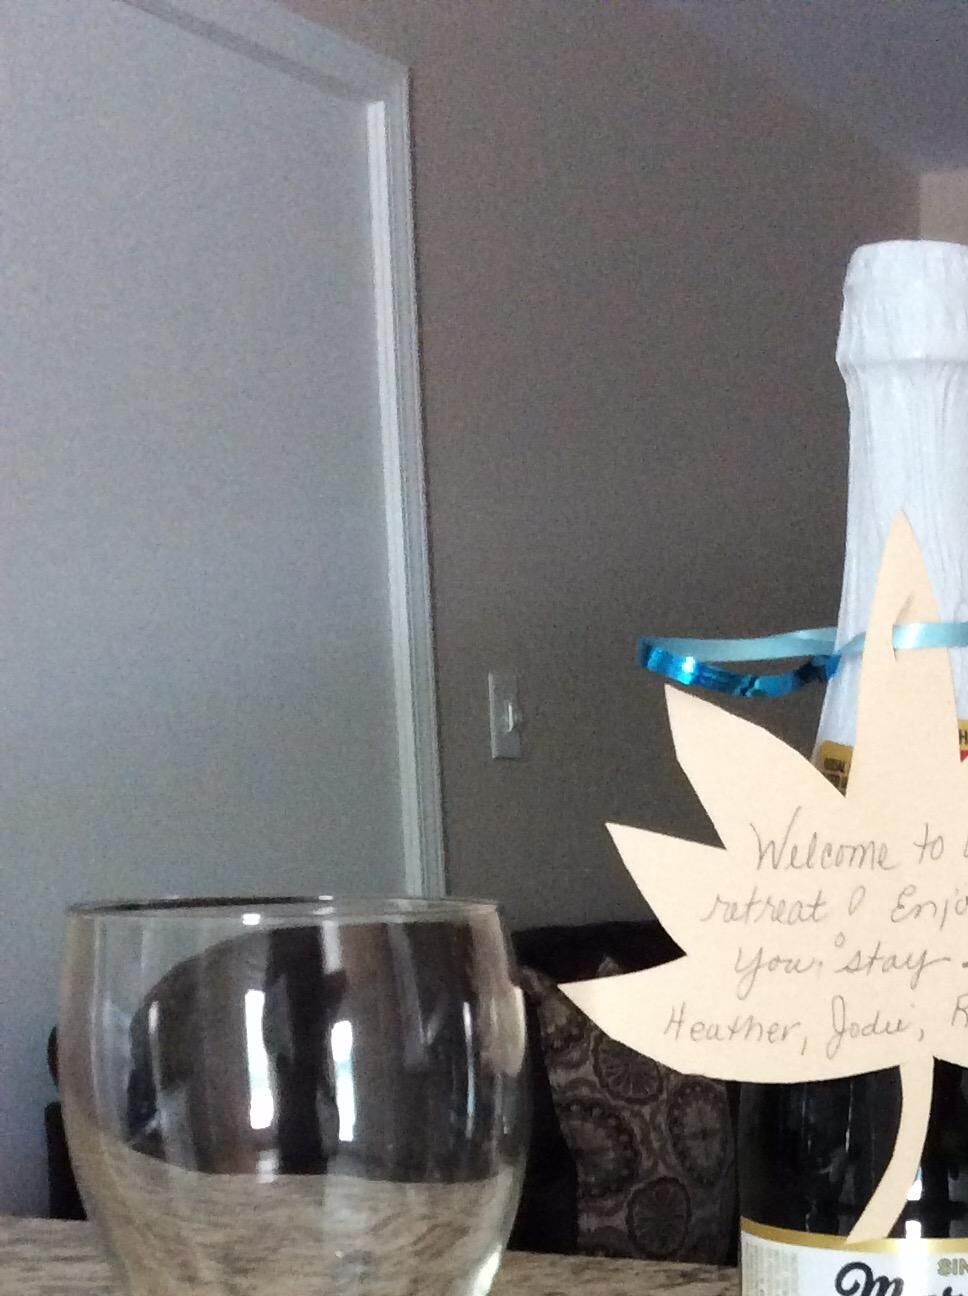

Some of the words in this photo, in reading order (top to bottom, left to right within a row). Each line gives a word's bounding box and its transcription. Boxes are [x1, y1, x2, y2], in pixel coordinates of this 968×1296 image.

[749, 805, 898, 871] Welcome
[913, 822, 944, 864] to
[663, 1000, 808, 1056] Heather,
